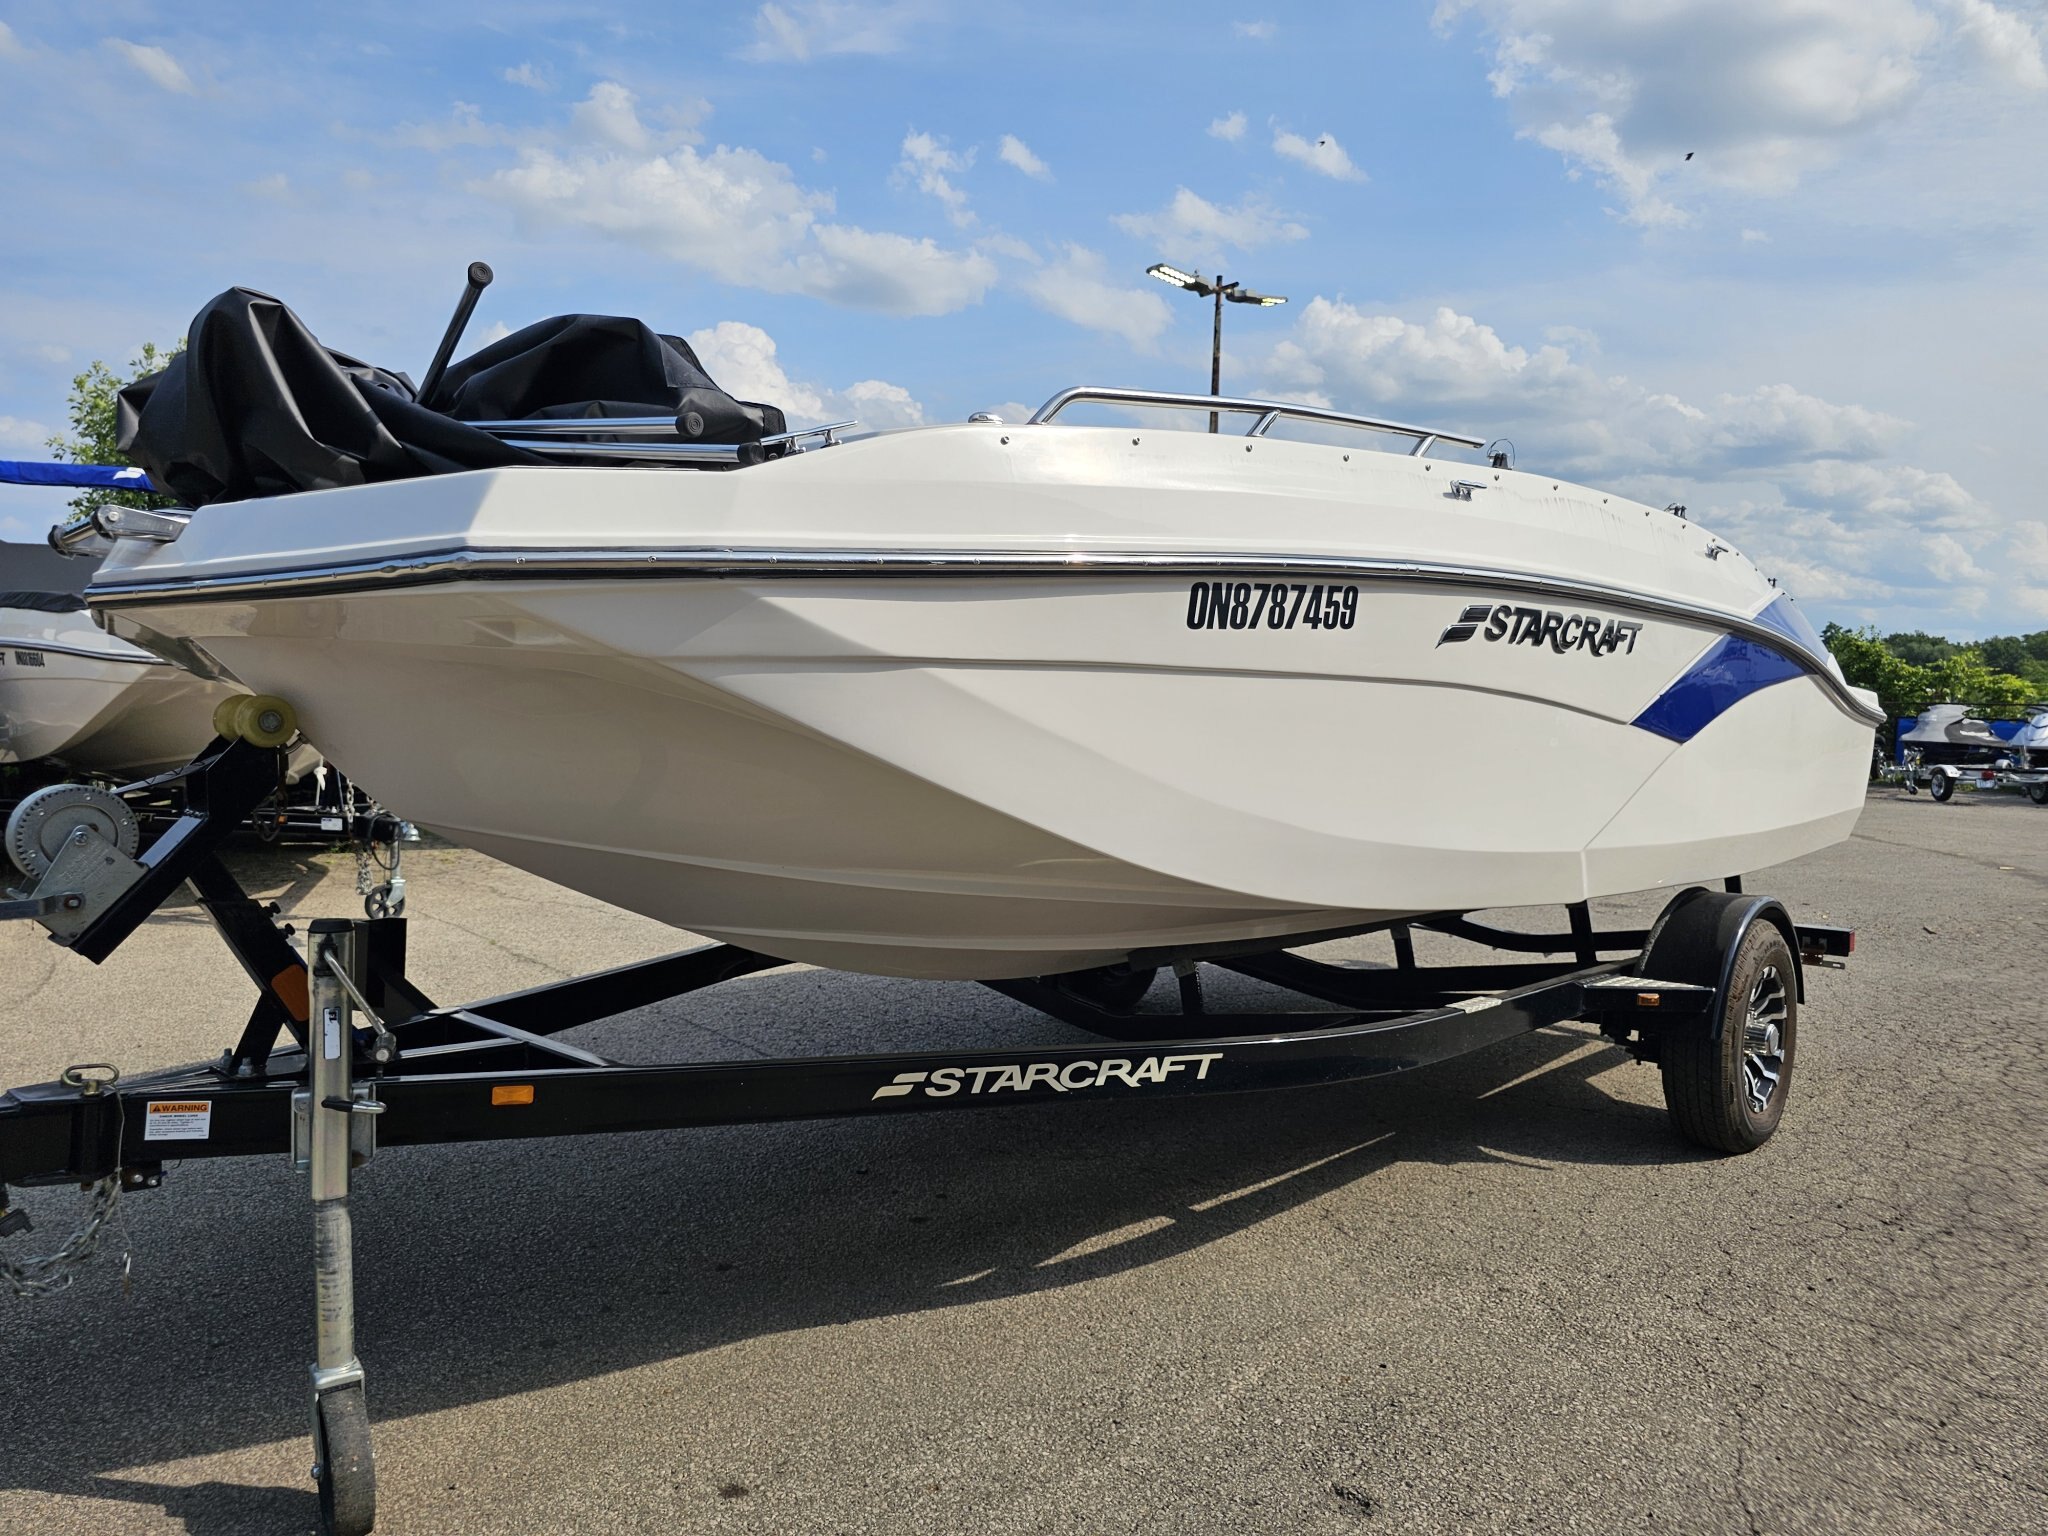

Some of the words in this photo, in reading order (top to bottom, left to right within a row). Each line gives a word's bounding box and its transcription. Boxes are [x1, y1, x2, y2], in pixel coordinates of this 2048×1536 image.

[1187, 582, 1359, 630] ON8787459
[1484, 604, 1643, 657] STARCRAFT
[925, 1053, 1223, 1097] STARCRAFT
[162, 1104, 207, 1112] WARNING
